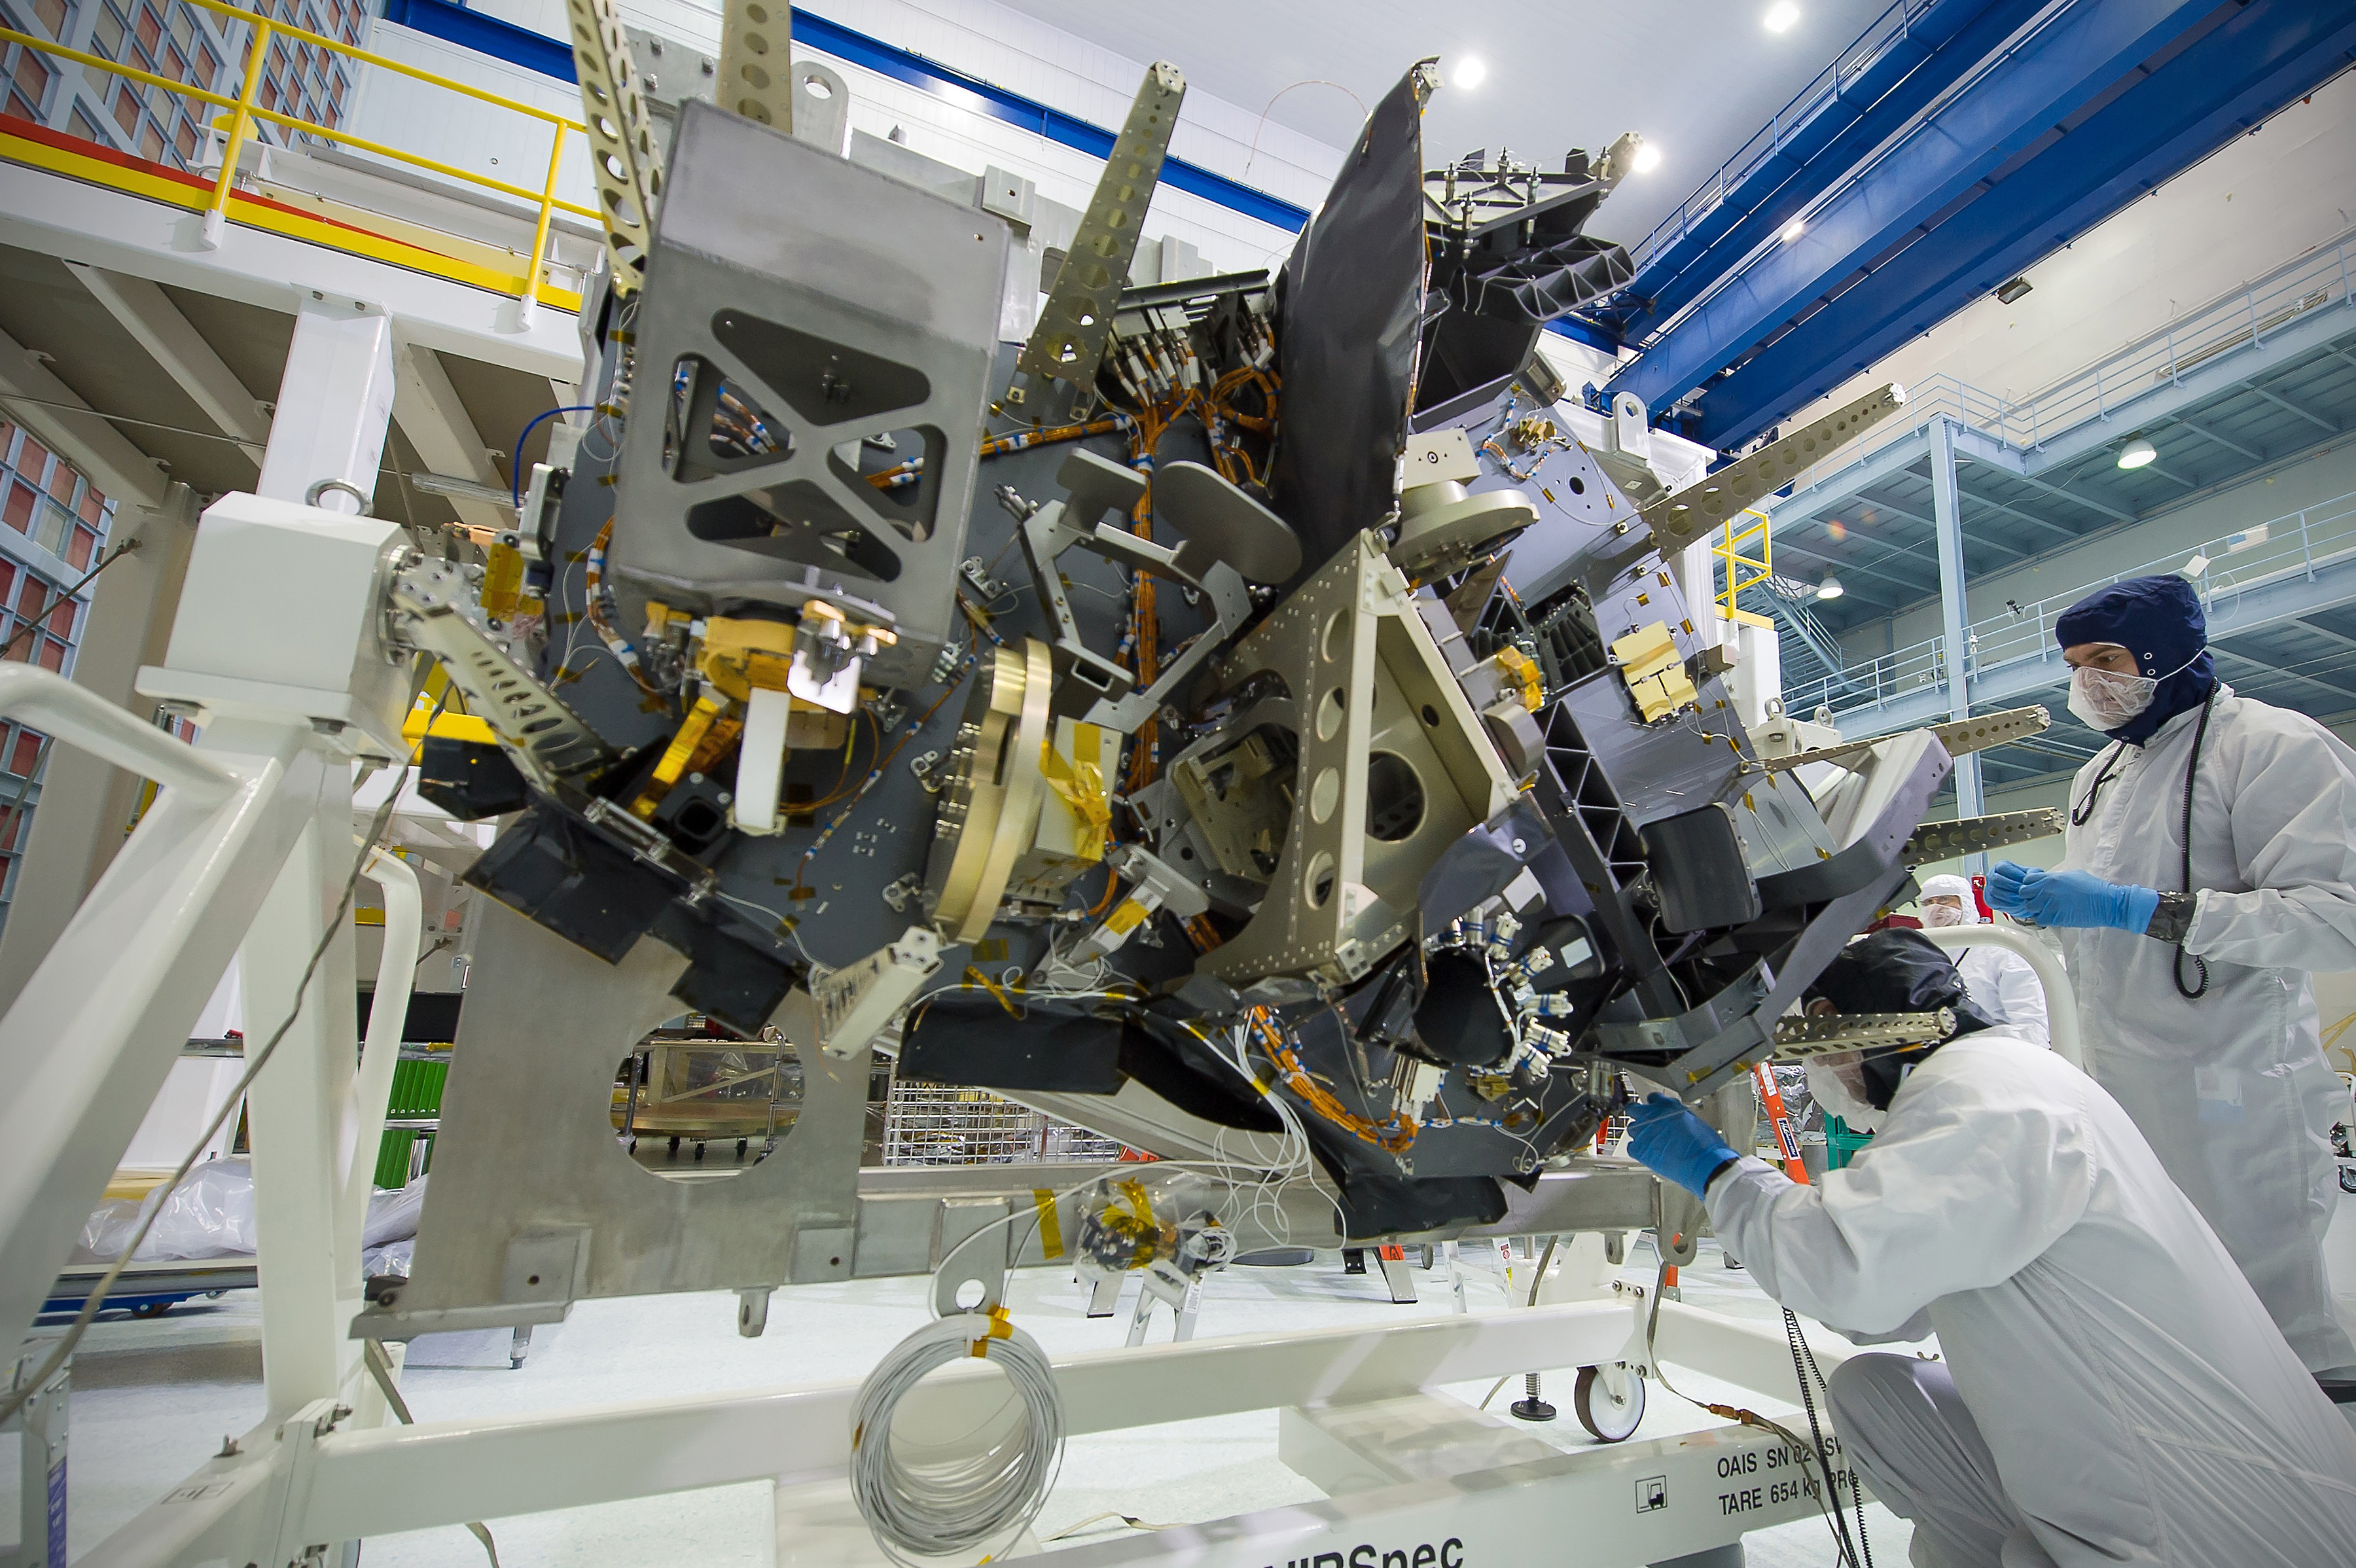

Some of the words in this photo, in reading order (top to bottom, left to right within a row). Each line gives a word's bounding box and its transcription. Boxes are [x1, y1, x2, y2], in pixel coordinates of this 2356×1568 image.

[1717, 1452, 1757, 1478] OAIS
[1767, 1446, 1789, 1469] SN
[1719, 1488, 1763, 1516] TARE
[1770, 1480, 1798, 1504] 654
